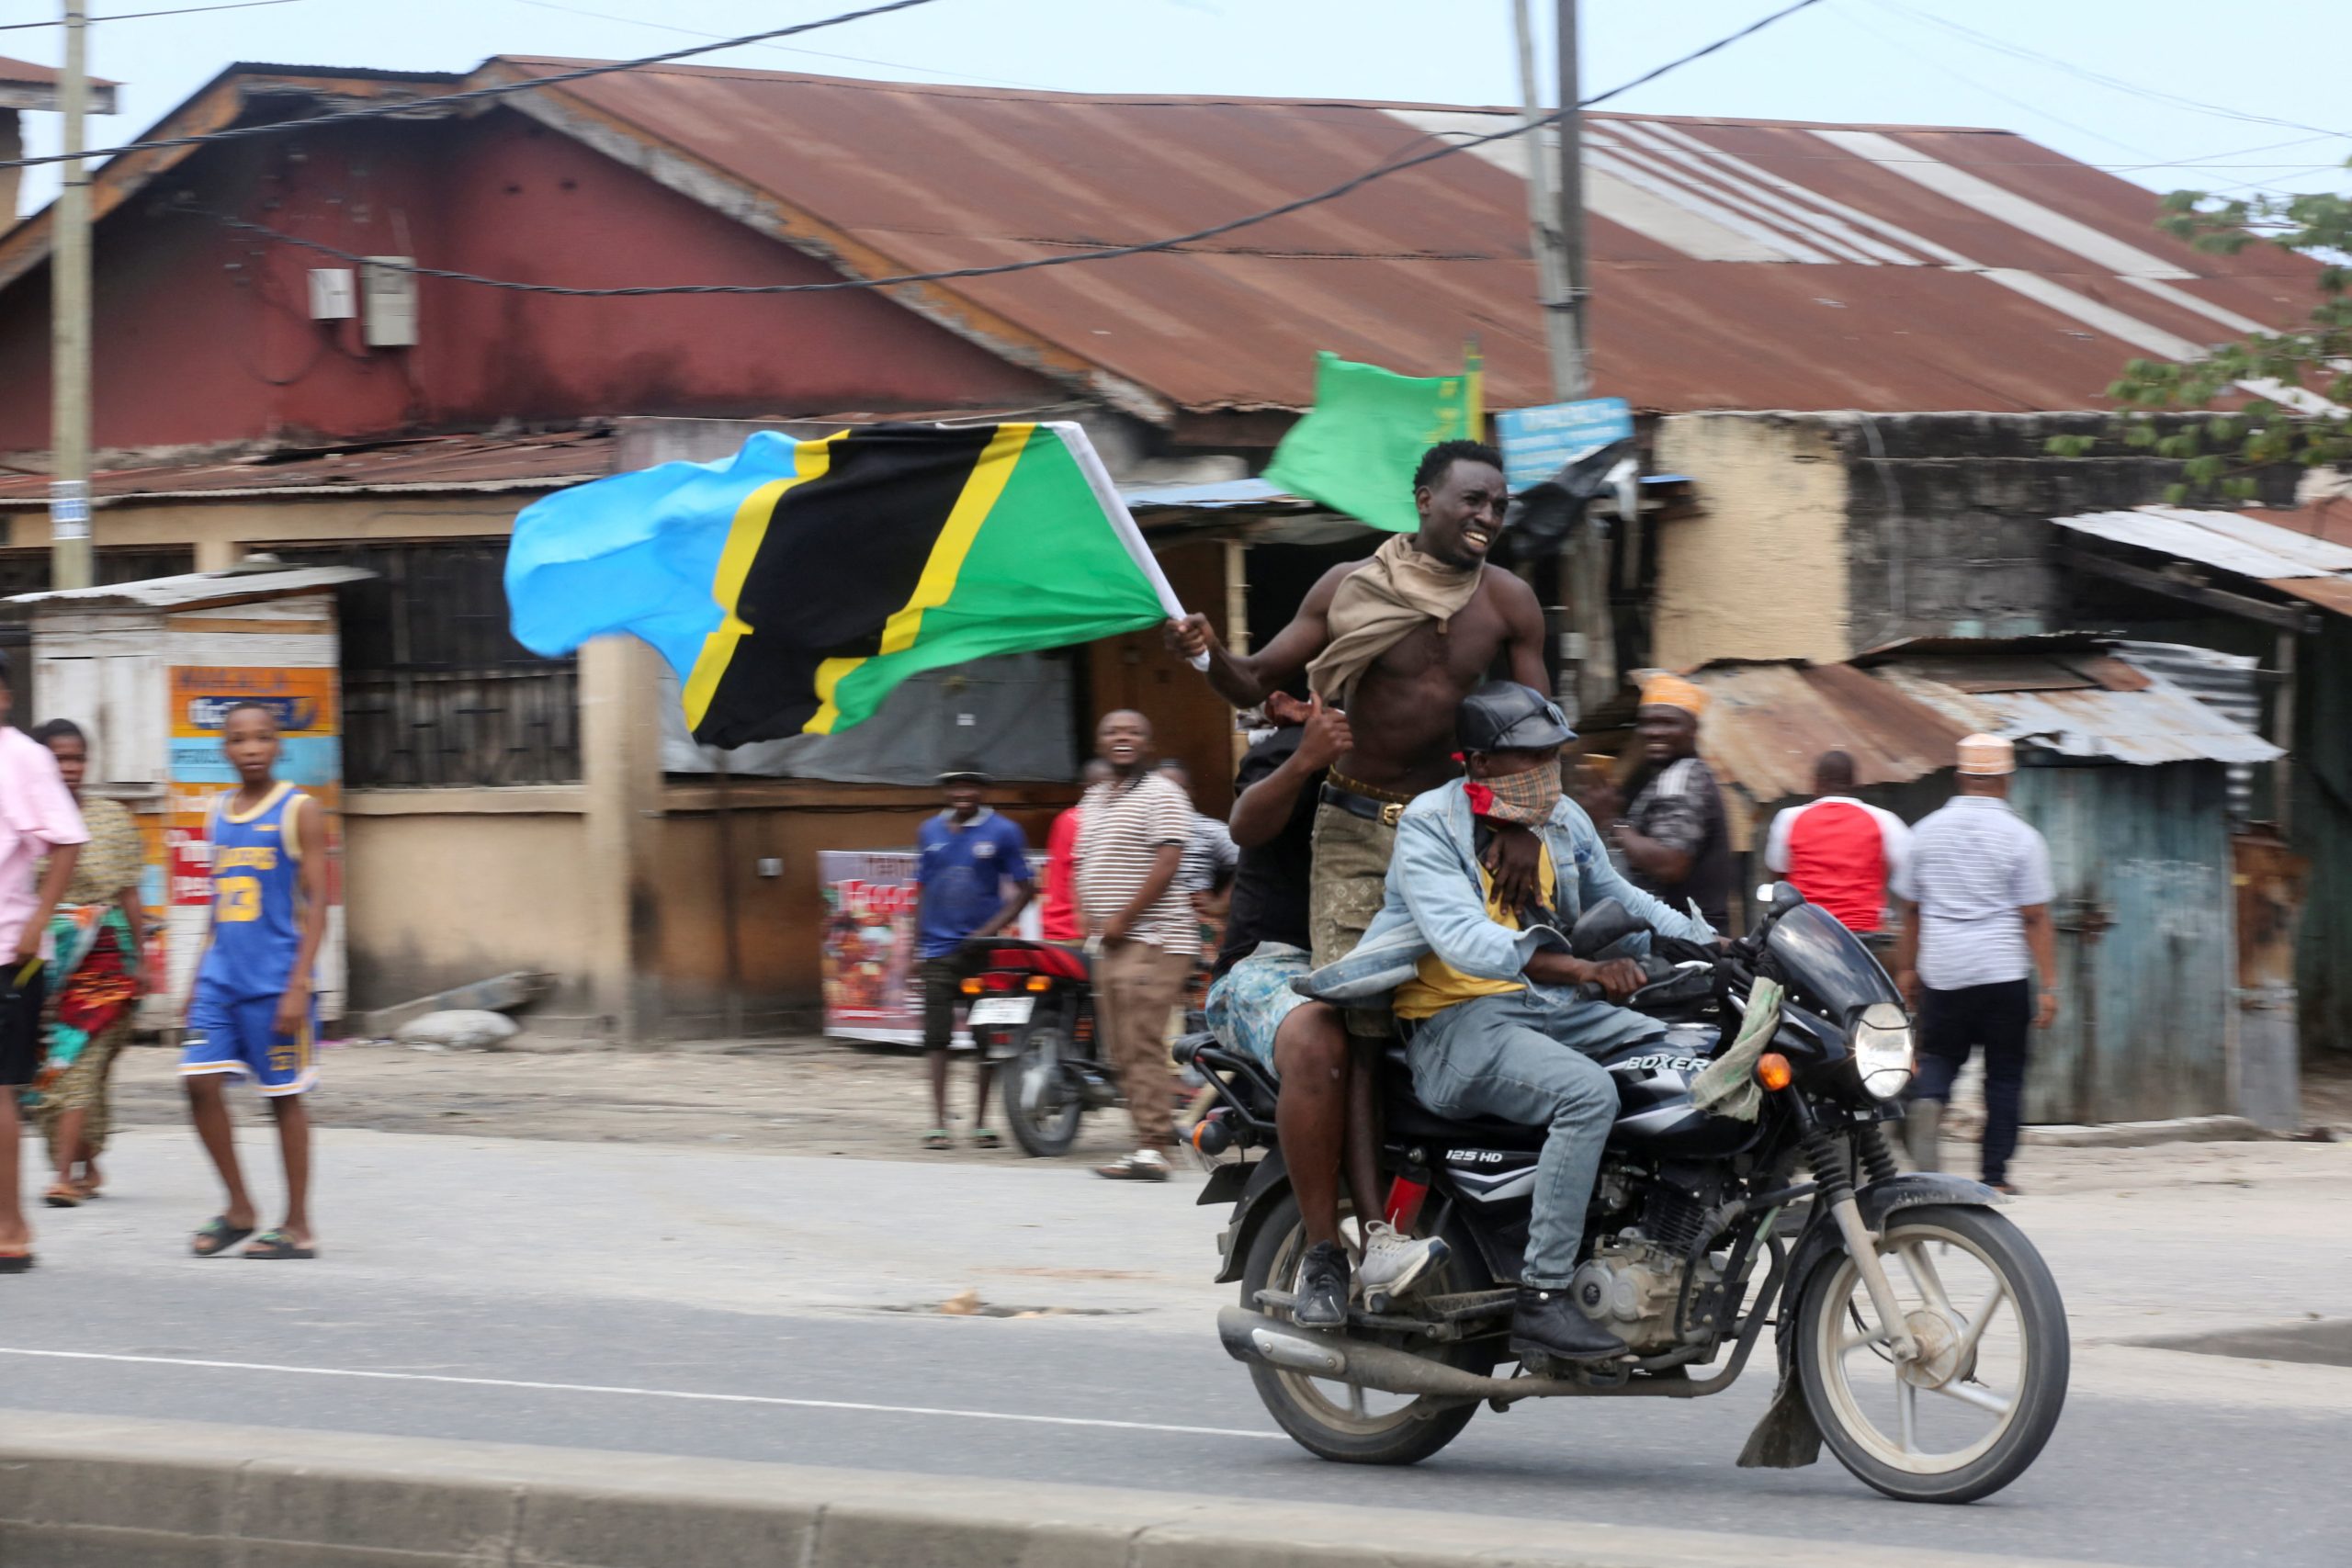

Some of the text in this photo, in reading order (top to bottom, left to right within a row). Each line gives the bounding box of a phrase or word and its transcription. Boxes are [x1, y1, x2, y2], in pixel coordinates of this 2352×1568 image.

[1624, 1055, 1711, 1072] BOXER
[1445, 1149, 1503, 1163] 125 HD
